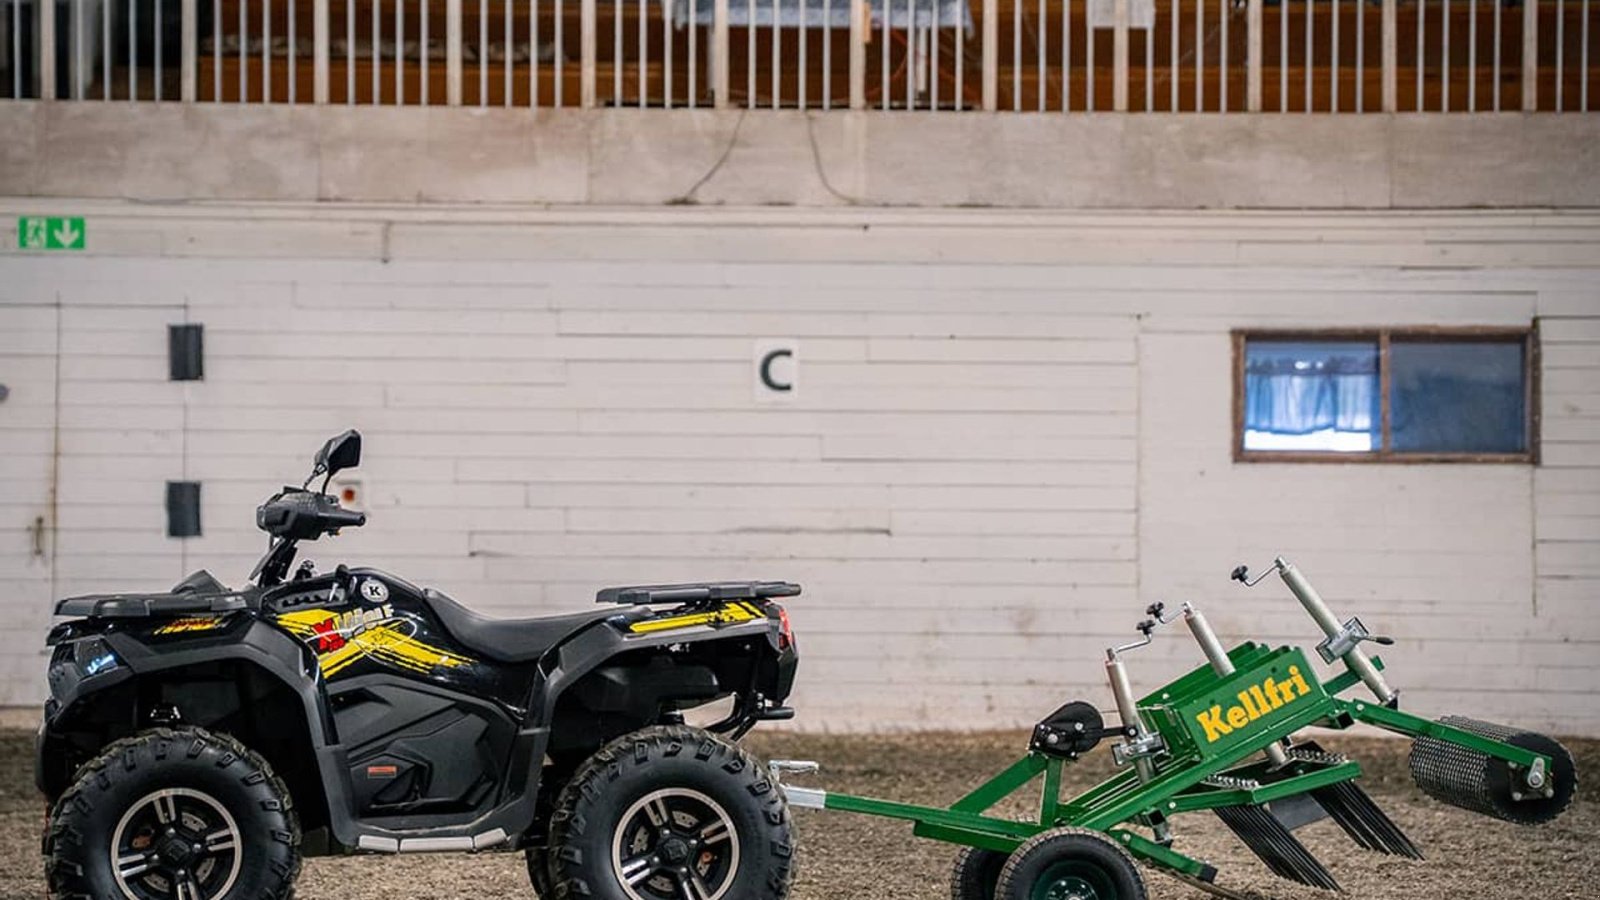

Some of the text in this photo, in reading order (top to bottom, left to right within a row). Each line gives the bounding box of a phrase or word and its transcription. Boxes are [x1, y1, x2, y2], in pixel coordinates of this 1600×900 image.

[759, 349, 792, 391] C
[369, 586, 381, 596] K
[1195, 665, 1311, 743] Kellfri
